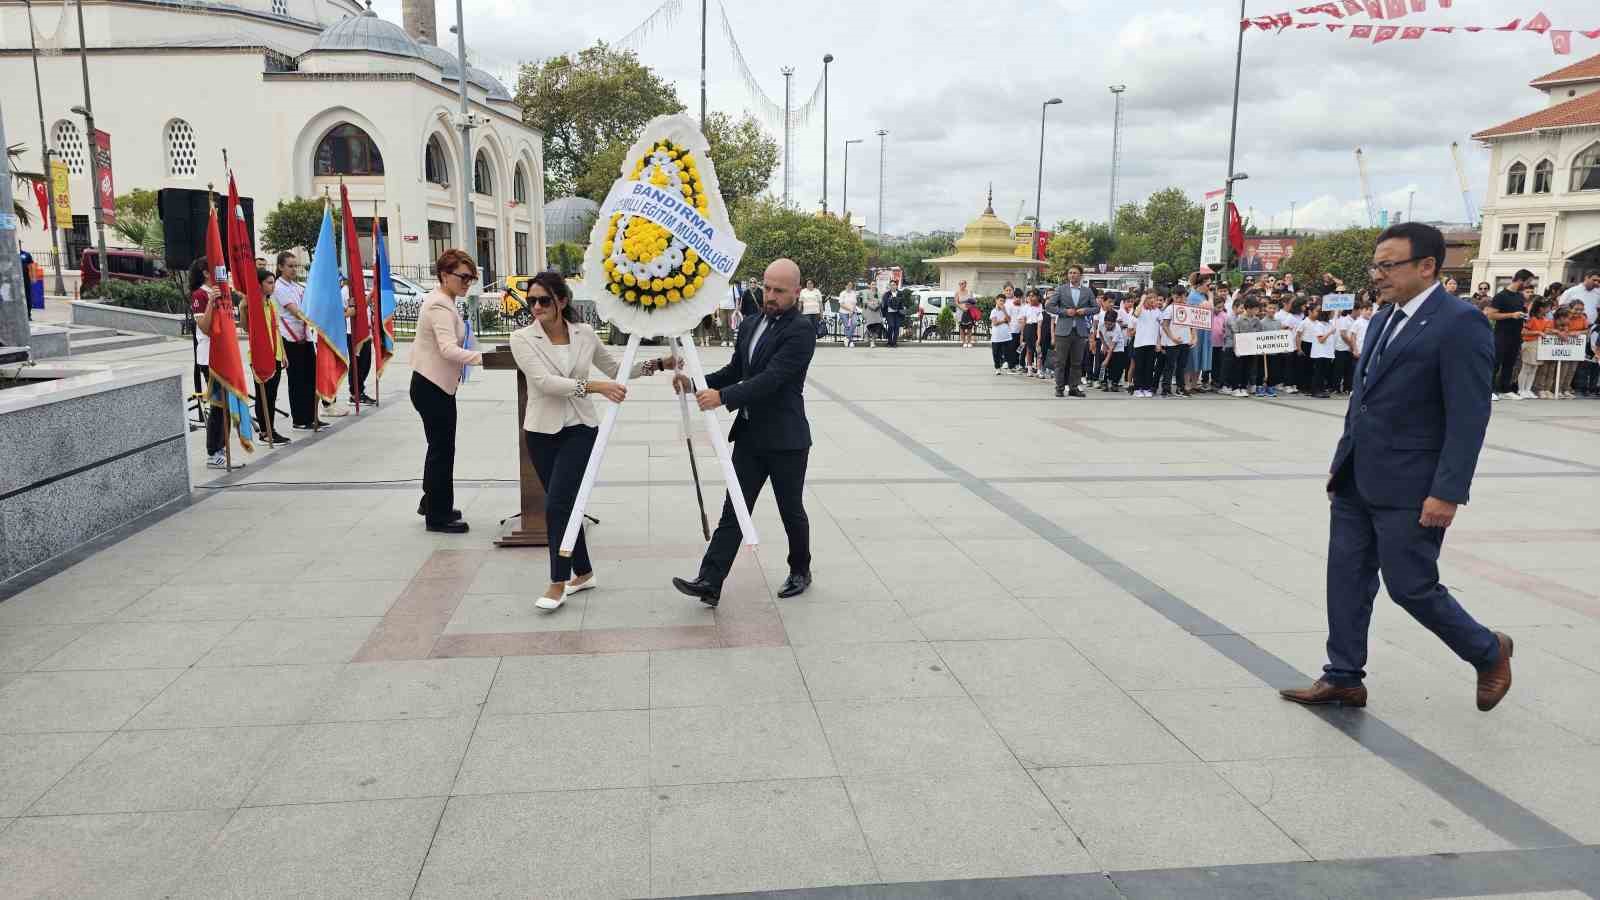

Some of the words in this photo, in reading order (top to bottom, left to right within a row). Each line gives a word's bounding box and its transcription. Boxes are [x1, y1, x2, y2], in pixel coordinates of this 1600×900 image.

[633, 183, 714, 240] BANDIRMA
[640, 201, 677, 228] EĞİTİM
[674, 222, 733, 273] MÜDÜRLÜĞÜ
